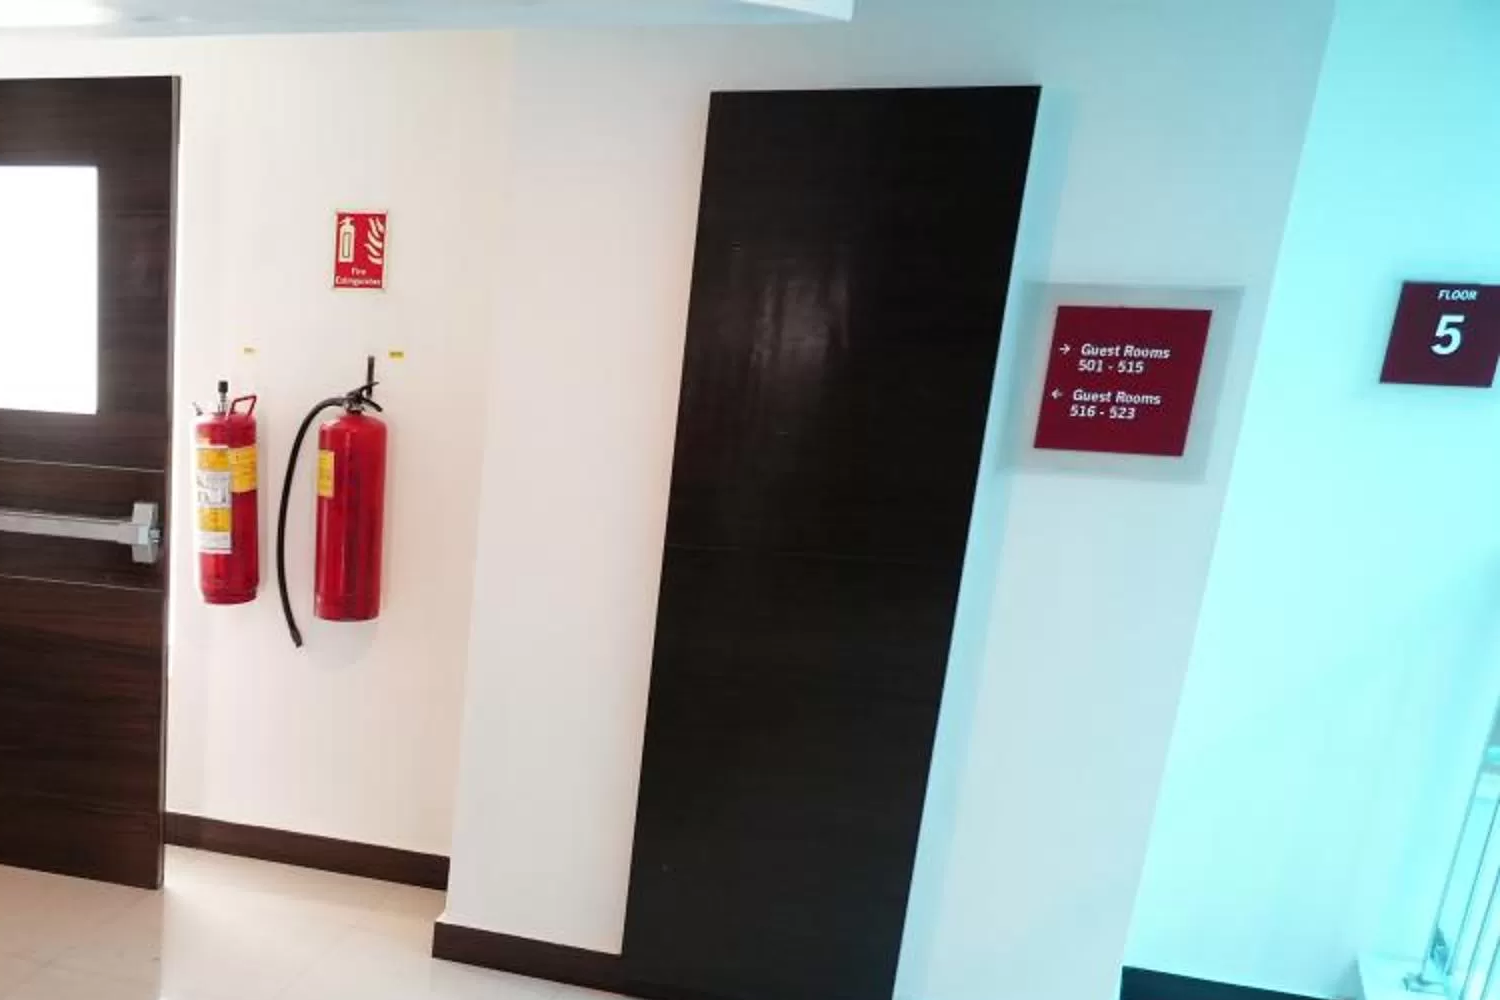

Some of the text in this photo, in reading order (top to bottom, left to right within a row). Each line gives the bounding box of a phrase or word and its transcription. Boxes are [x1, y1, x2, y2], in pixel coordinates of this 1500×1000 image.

[1437, 289, 1478, 301] FLOOR
[1430, 314, 1465, 355] 5
[1080, 343, 1171, 359] Guest Rooms
[1077, 359, 1104, 373] 501
[1117, 360, 1145, 374] 515
[1072, 388, 1162, 405] Guest Rooms
[1069, 404, 1097, 417] 516
[1109, 406, 1136, 420] 523
